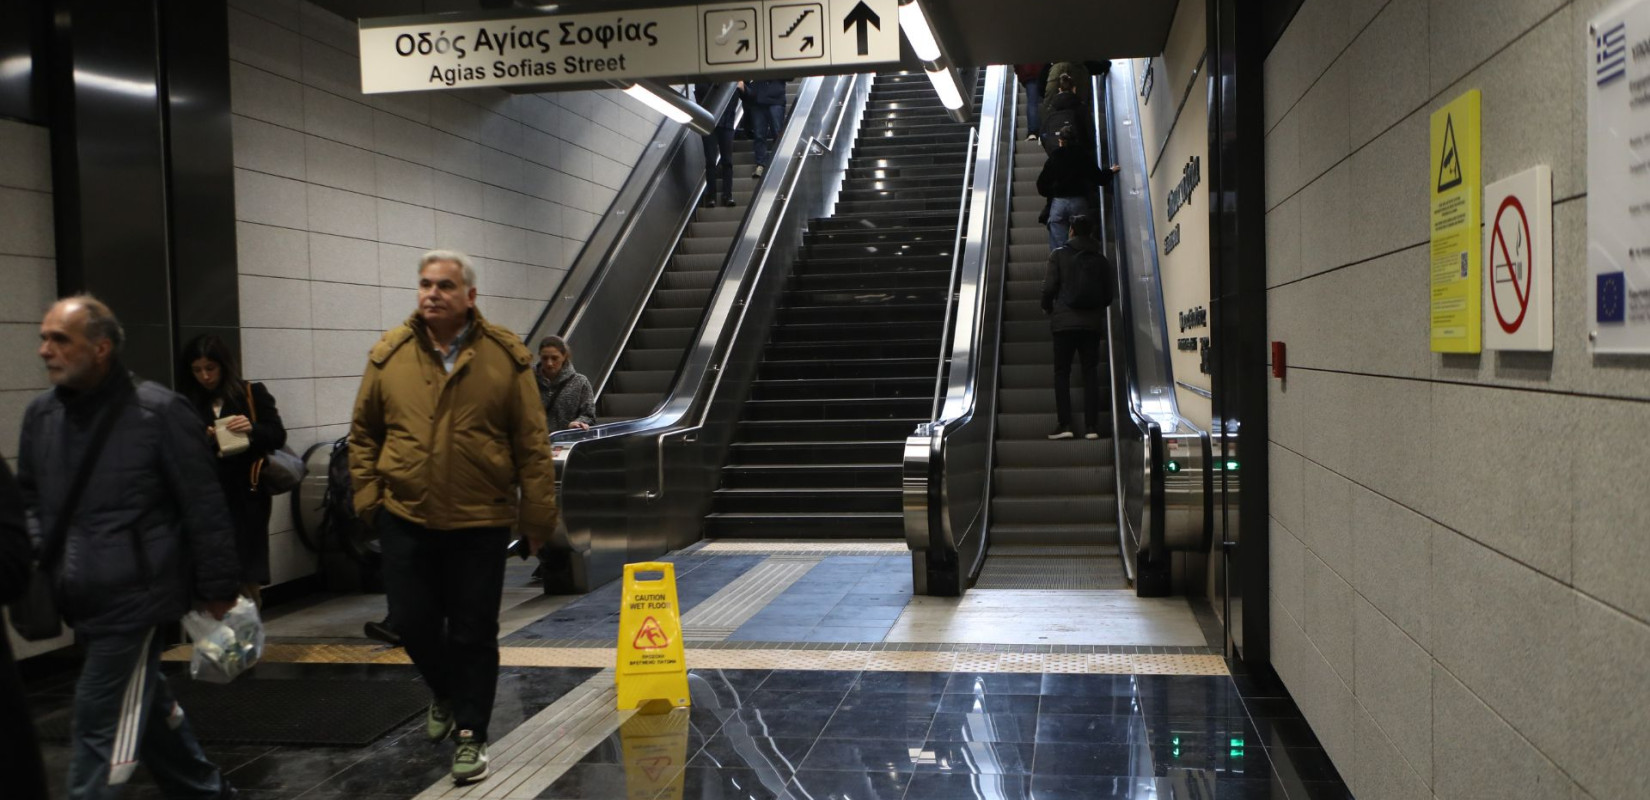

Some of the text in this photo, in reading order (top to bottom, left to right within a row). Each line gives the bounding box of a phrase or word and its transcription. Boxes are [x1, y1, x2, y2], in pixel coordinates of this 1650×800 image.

[395, 18, 658, 59] Οδός Αγίας Σοφίας
[429, 53, 626, 85] Agias Sofias Street
[630, 602, 645, 610] WET
